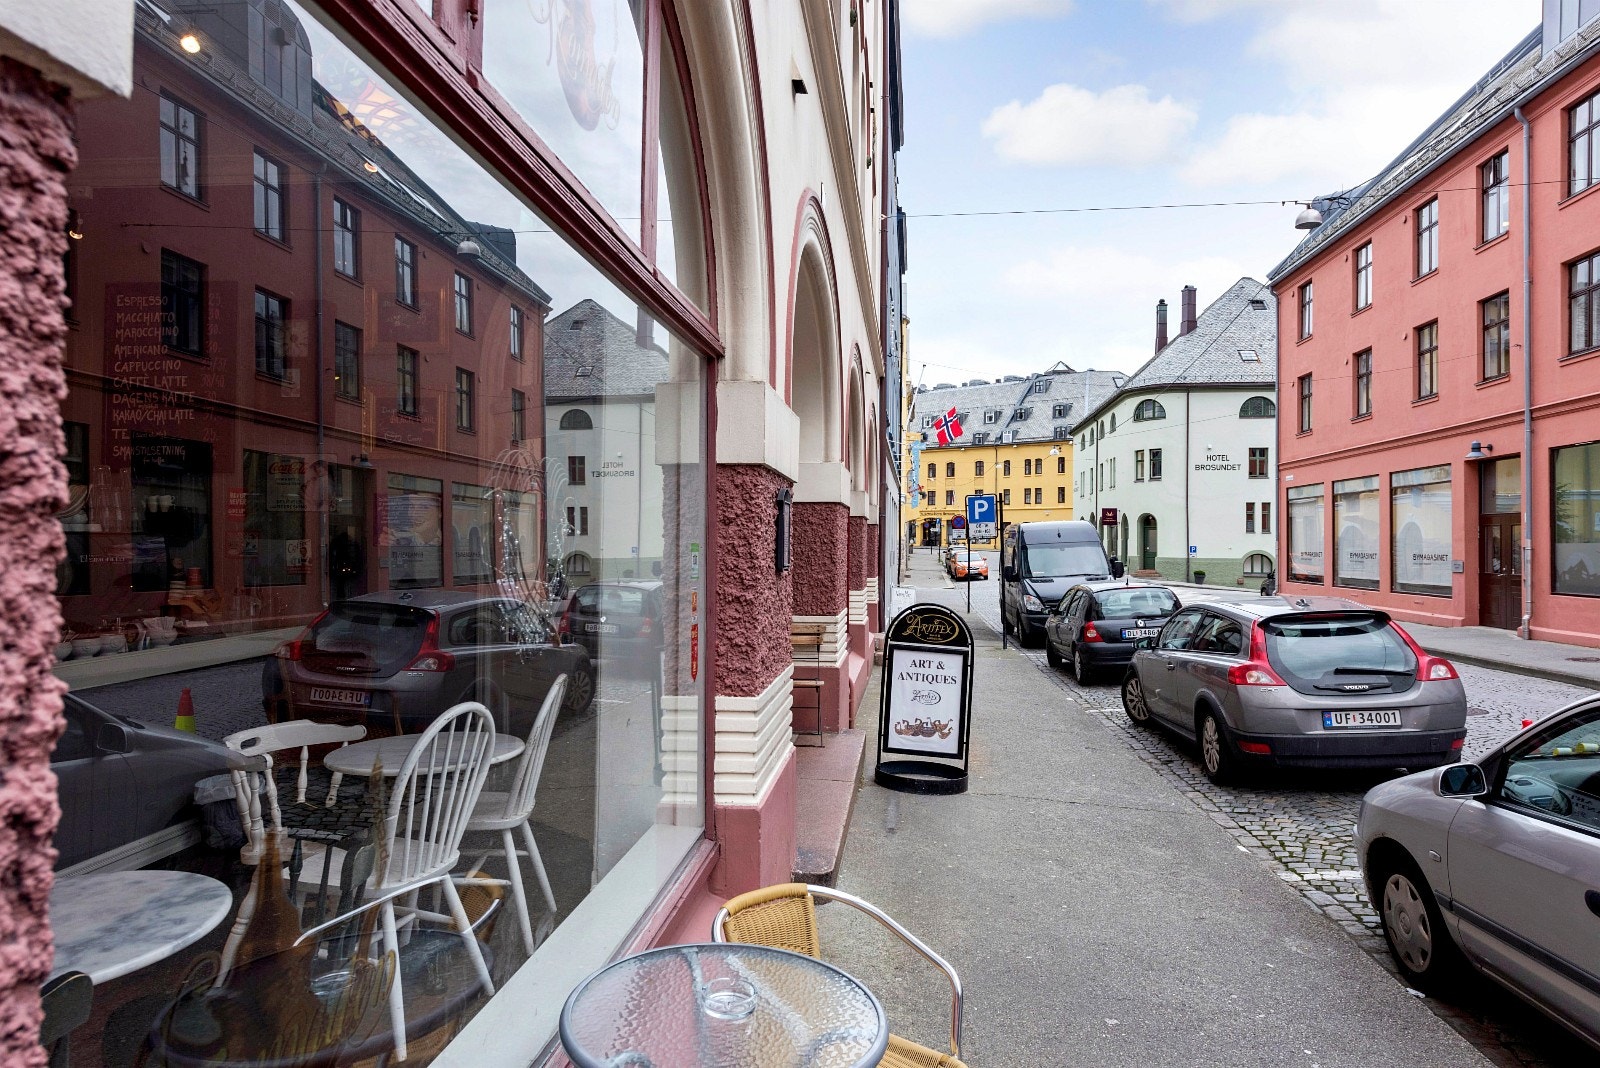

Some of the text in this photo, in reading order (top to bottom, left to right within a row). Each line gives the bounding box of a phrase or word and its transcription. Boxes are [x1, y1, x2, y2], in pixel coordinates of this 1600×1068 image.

[116, 295, 168, 308] ESPRESSO
[116, 312, 176, 327] MACCHIATO
[115, 326, 179, 342] MAROCCHINO
[114, 344, 168, 359] AMERICANO
[114, 360, 181, 373] CAPPUCCINO
[154, 376, 188, 389] LATTE
[112, 392, 159, 408] DAGENS
[169, 409, 195, 424] LATTE
[111, 428, 130, 440] TE
[974, 499, 989, 519] P
[1412, 553, 1449, 561] BYMAGASINET
[909, 659, 946, 670] ART &
[897, 671, 957, 685] ANTIQUES
[1334, 712, 1350, 724] UF
[1358, 711, 1398, 724] 34001
